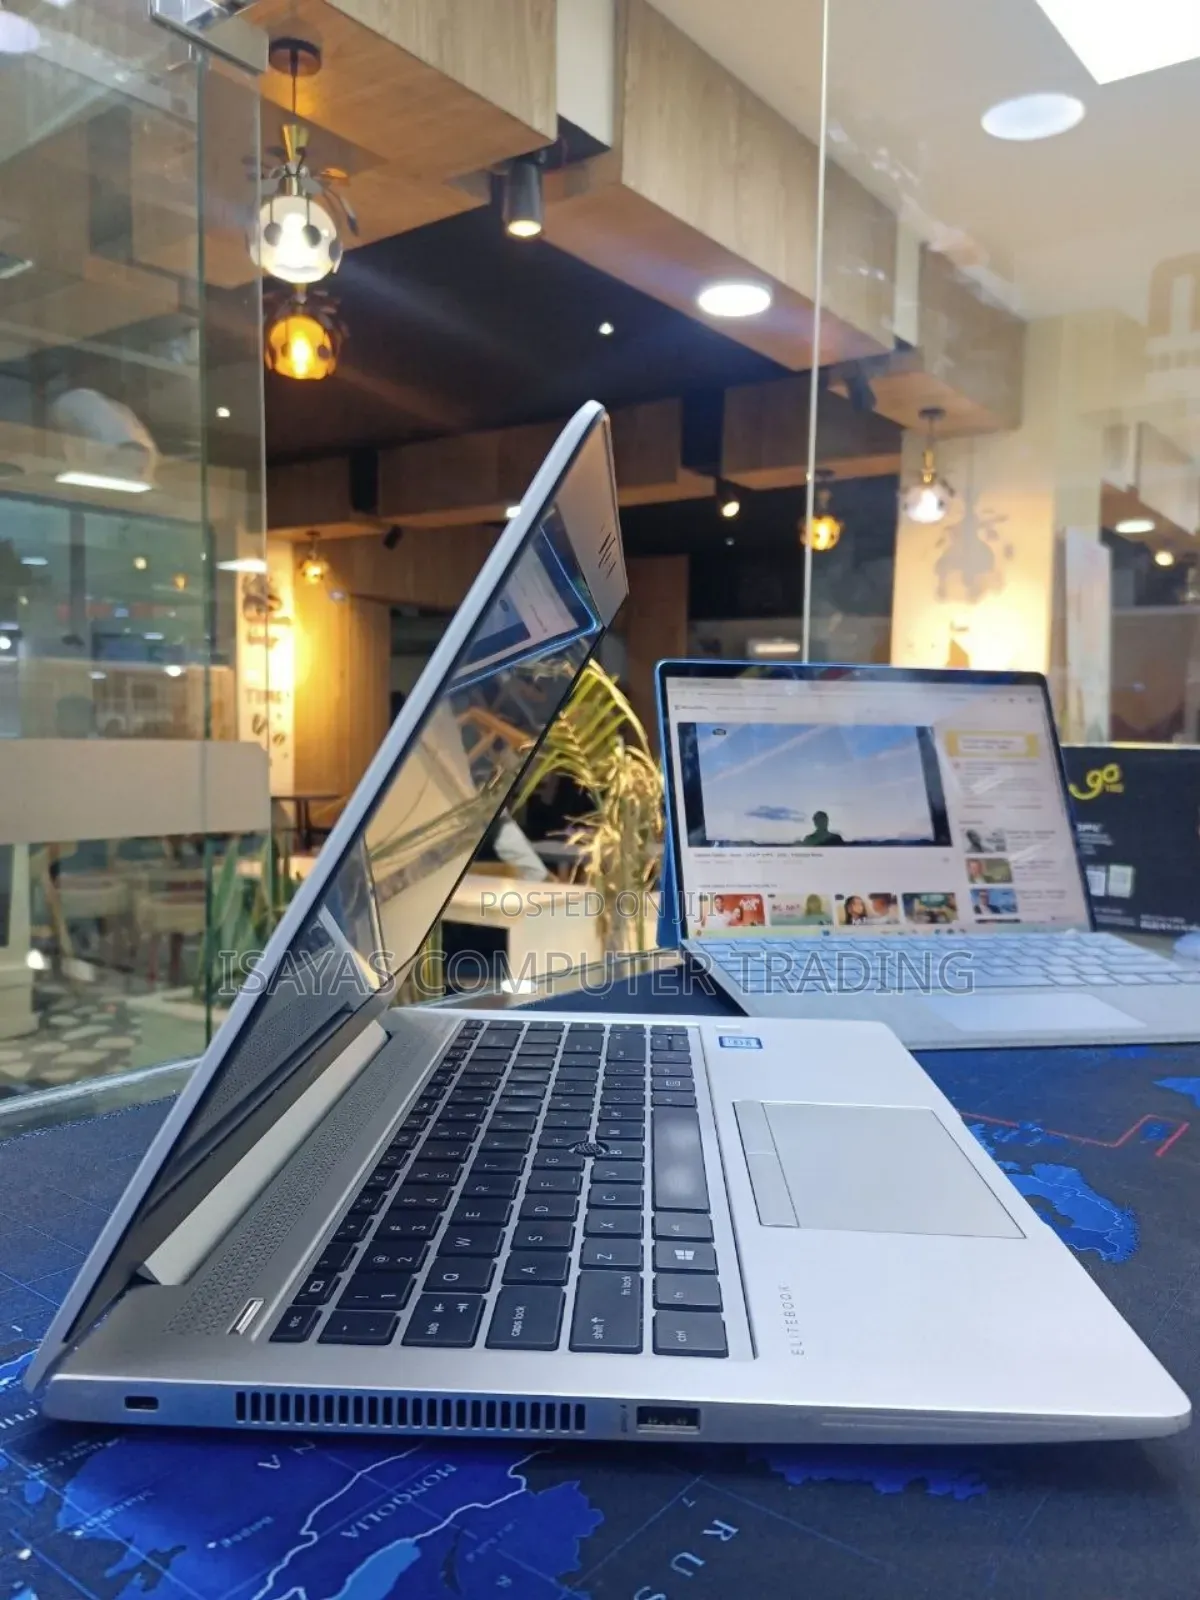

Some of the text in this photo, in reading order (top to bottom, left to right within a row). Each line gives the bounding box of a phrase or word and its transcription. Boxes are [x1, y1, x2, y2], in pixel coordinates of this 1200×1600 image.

[534, 1205, 549, 1213] D
[600, 1221, 615, 1229] X
[454, 1236, 472, 1248] W
[597, 1252, 613, 1260] Z
[521, 1265, 537, 1275] A
[442, 1272, 460, 1282] Q
[779, 1282, 805, 1356] ELITEBOOK
[511, 1319, 523, 1337] caps
[593, 1323, 605, 1340] shift
[676, 1330, 687, 1342] ctrl
[340, 1463, 458, 1539] MONGOLIA
